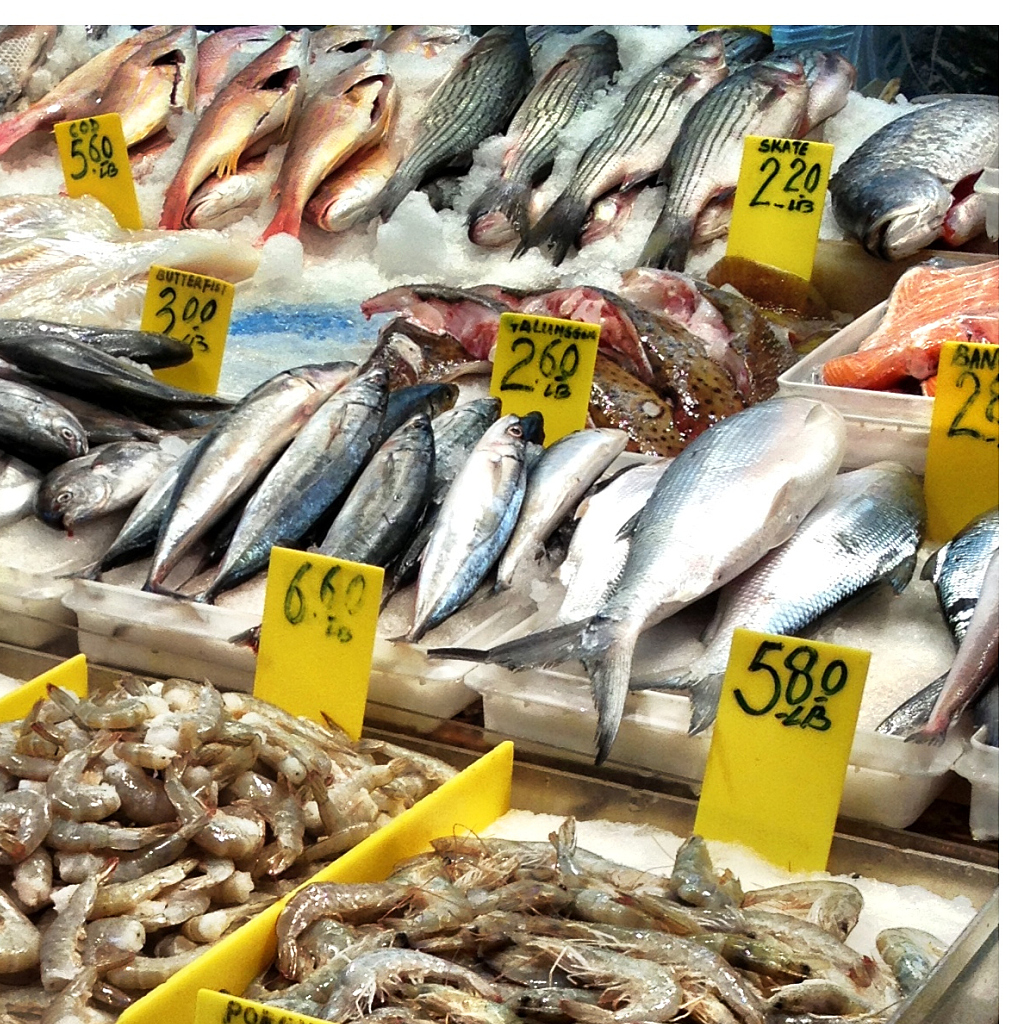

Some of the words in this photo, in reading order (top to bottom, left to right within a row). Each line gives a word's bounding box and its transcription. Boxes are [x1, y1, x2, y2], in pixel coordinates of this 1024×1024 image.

[69, 118, 99, 138] COD
[758, 139, 809, 156] SKATE
[543, 384, 571, 399] LB
